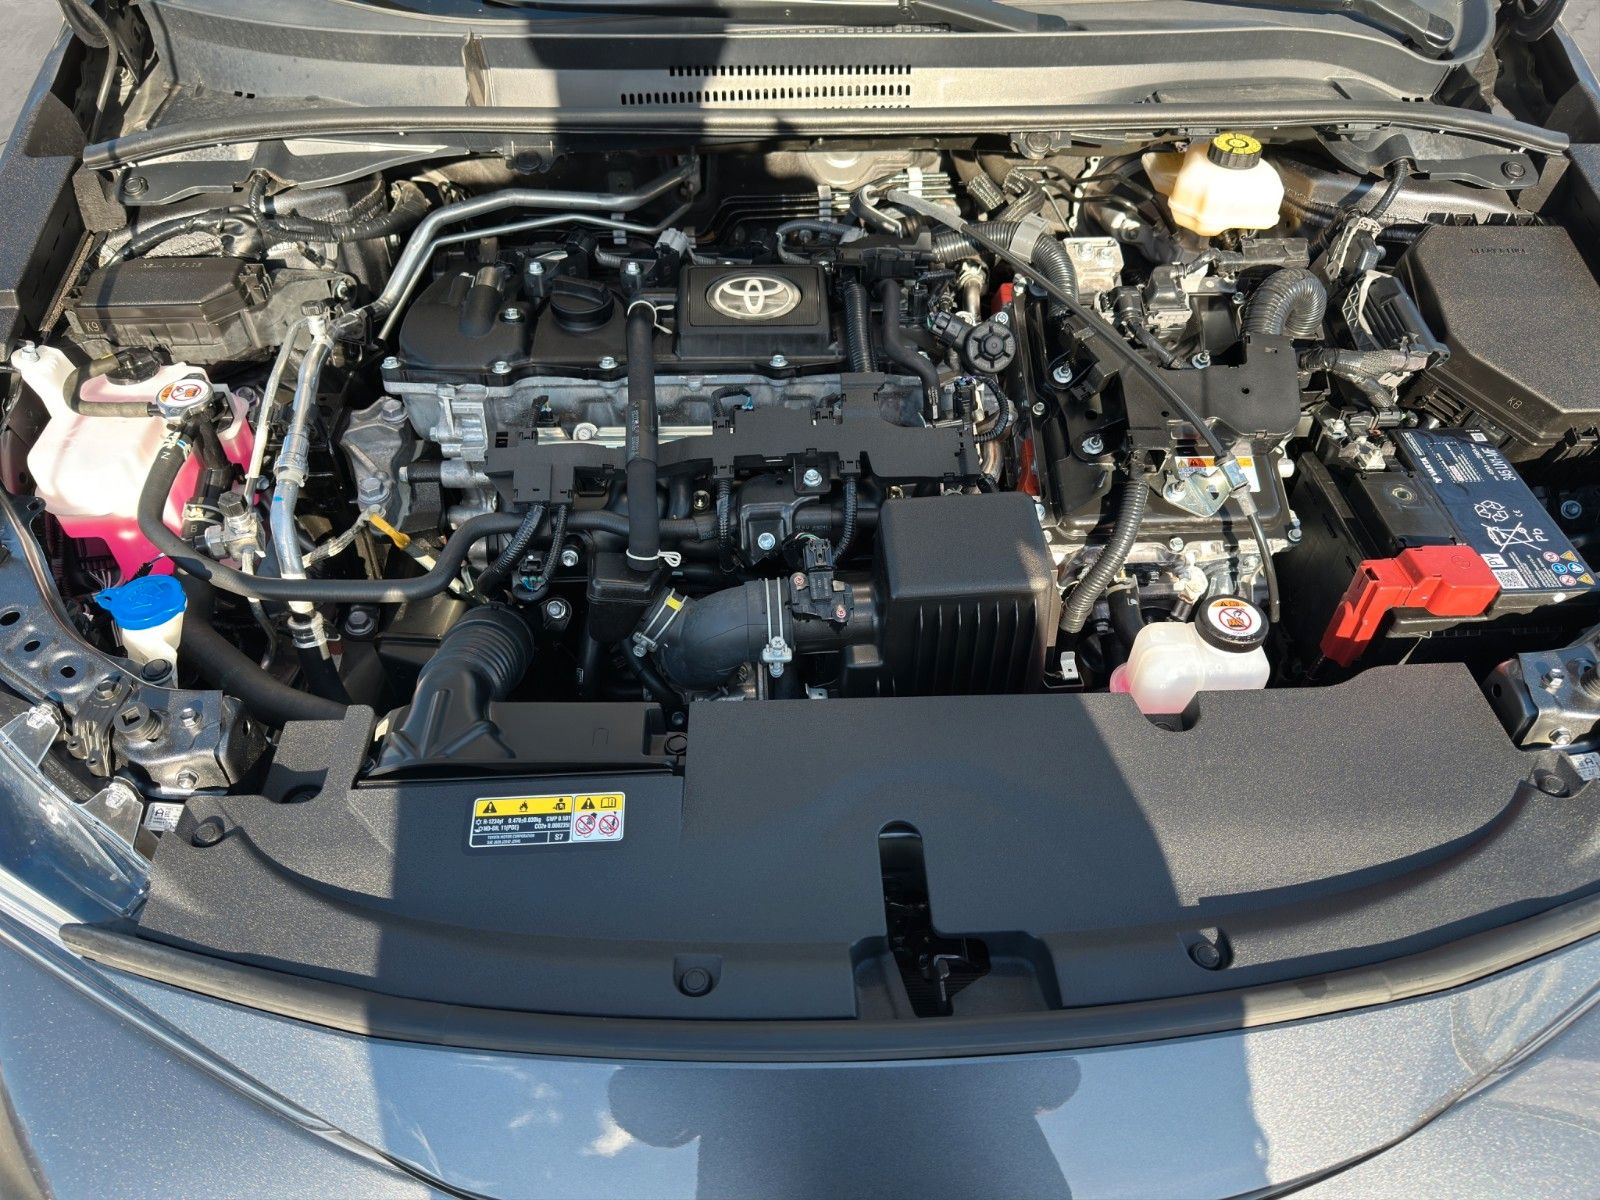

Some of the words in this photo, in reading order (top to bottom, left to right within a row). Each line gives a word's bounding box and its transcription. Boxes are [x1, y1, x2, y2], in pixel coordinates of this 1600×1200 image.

[85, 321, 99, 332] K9
[1420, 457, 1437, 477] VARTA
[1533, 527, 1549, 542] Pb
[554, 833, 564, 841] S7
